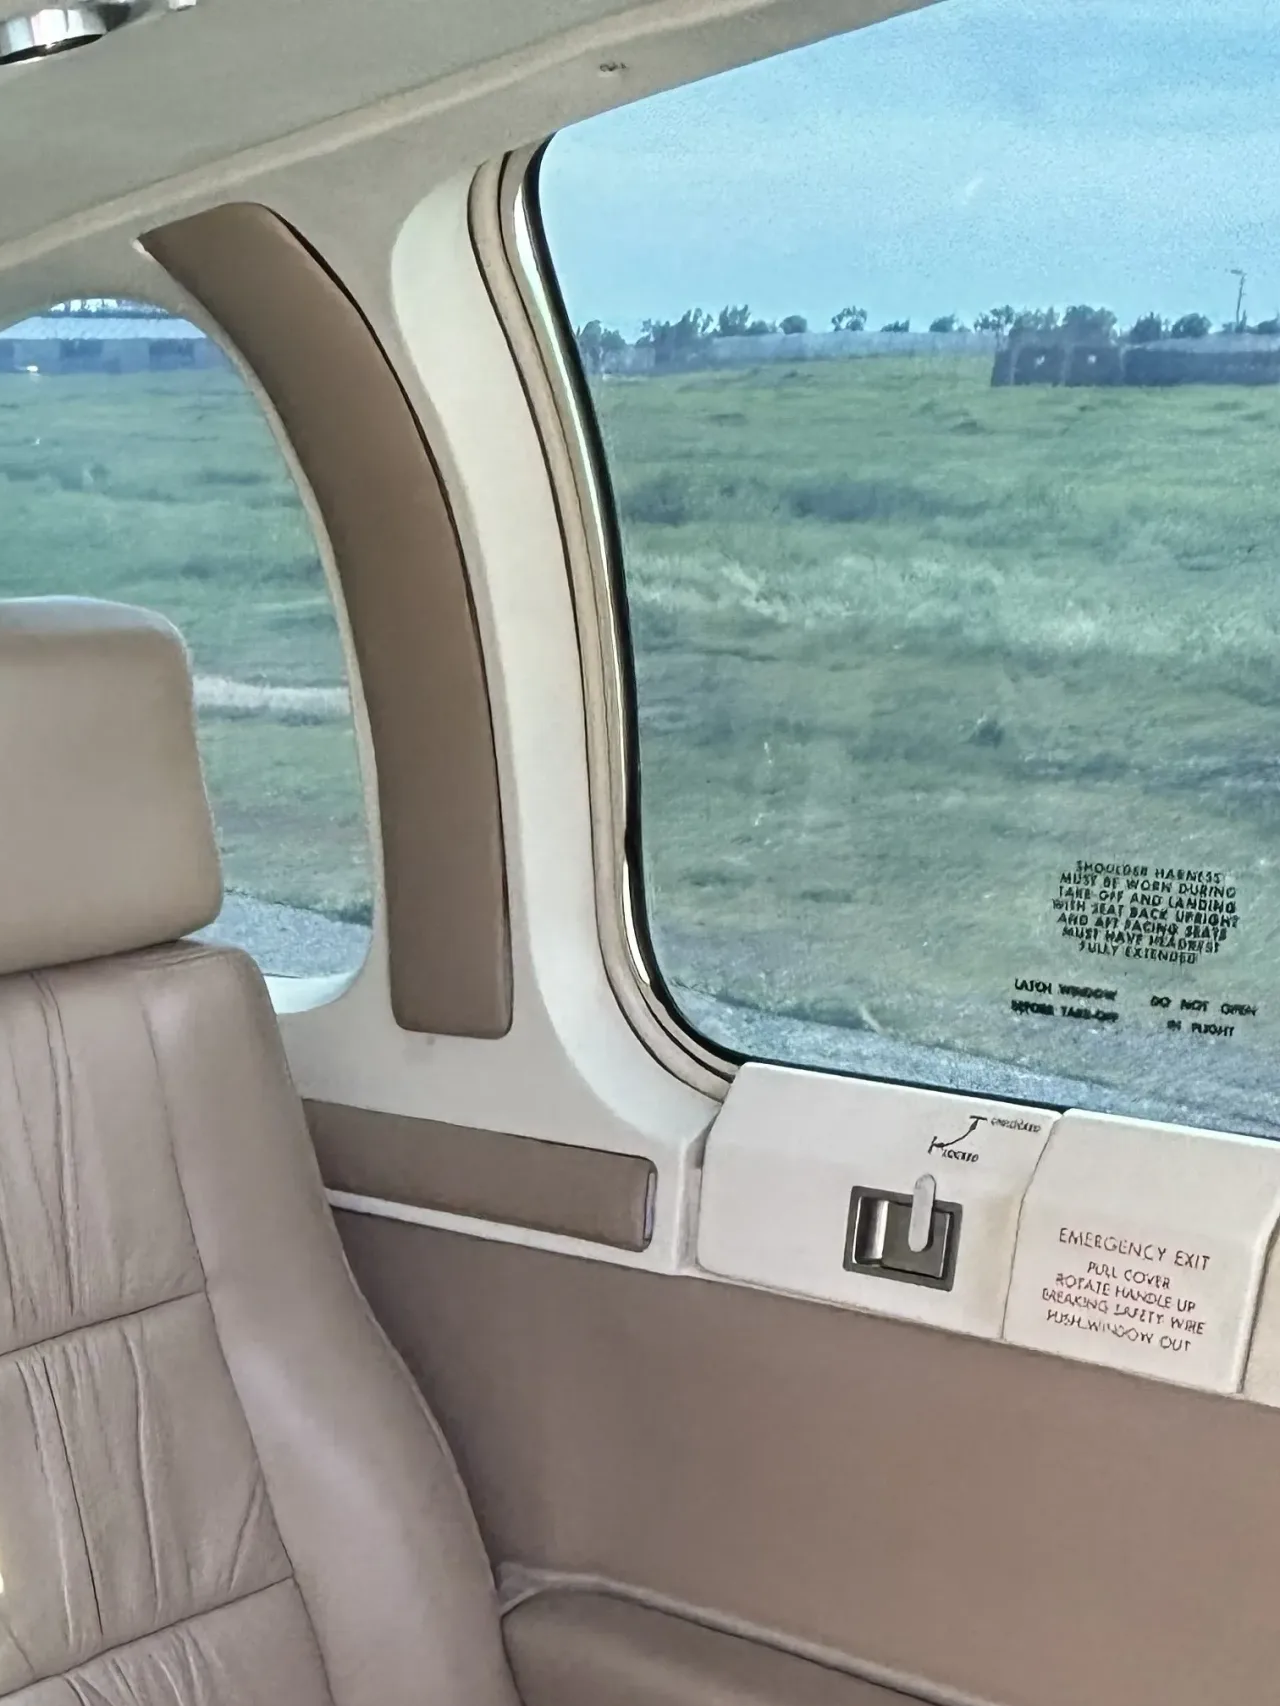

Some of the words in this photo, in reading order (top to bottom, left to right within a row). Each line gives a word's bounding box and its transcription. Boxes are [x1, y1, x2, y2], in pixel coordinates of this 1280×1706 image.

[1052, 898, 1086, 912] WITH
[1091, 902, 1125, 917] SEAT
[1129, 907, 1168, 920] BACK
[1129, 892, 1163, 907] AND
[1168, 898, 1237, 915] LANDING
[1057, 912, 1089, 927] AND
[1124, 919, 1179, 936] FACING
[1062, 926, 1099, 940] MUST
[1105, 929, 1144, 946] HAVE
[1149, 994, 1173, 1009] DO
[1180, 997, 1210, 1013] NOT
[1058, 1227, 1168, 1262] EMERGENCY
[1173, 1250, 1212, 1271] EXIT
[1086, 1261, 1119, 1280] PULL
[1124, 1269, 1172, 1290] COVER
[1055, 1273, 1111, 1297] ROTATE
[1115, 1287, 1173, 1310] HANDLE
[1177, 1298, 1197, 1313] UP
[1042, 1287, 1109, 1315] BREAKING
[1170, 1317, 1207, 1336] WIRE
[1087, 1320, 1155, 1345] WINDOW
[1159, 1334, 1193, 1353] OUT
